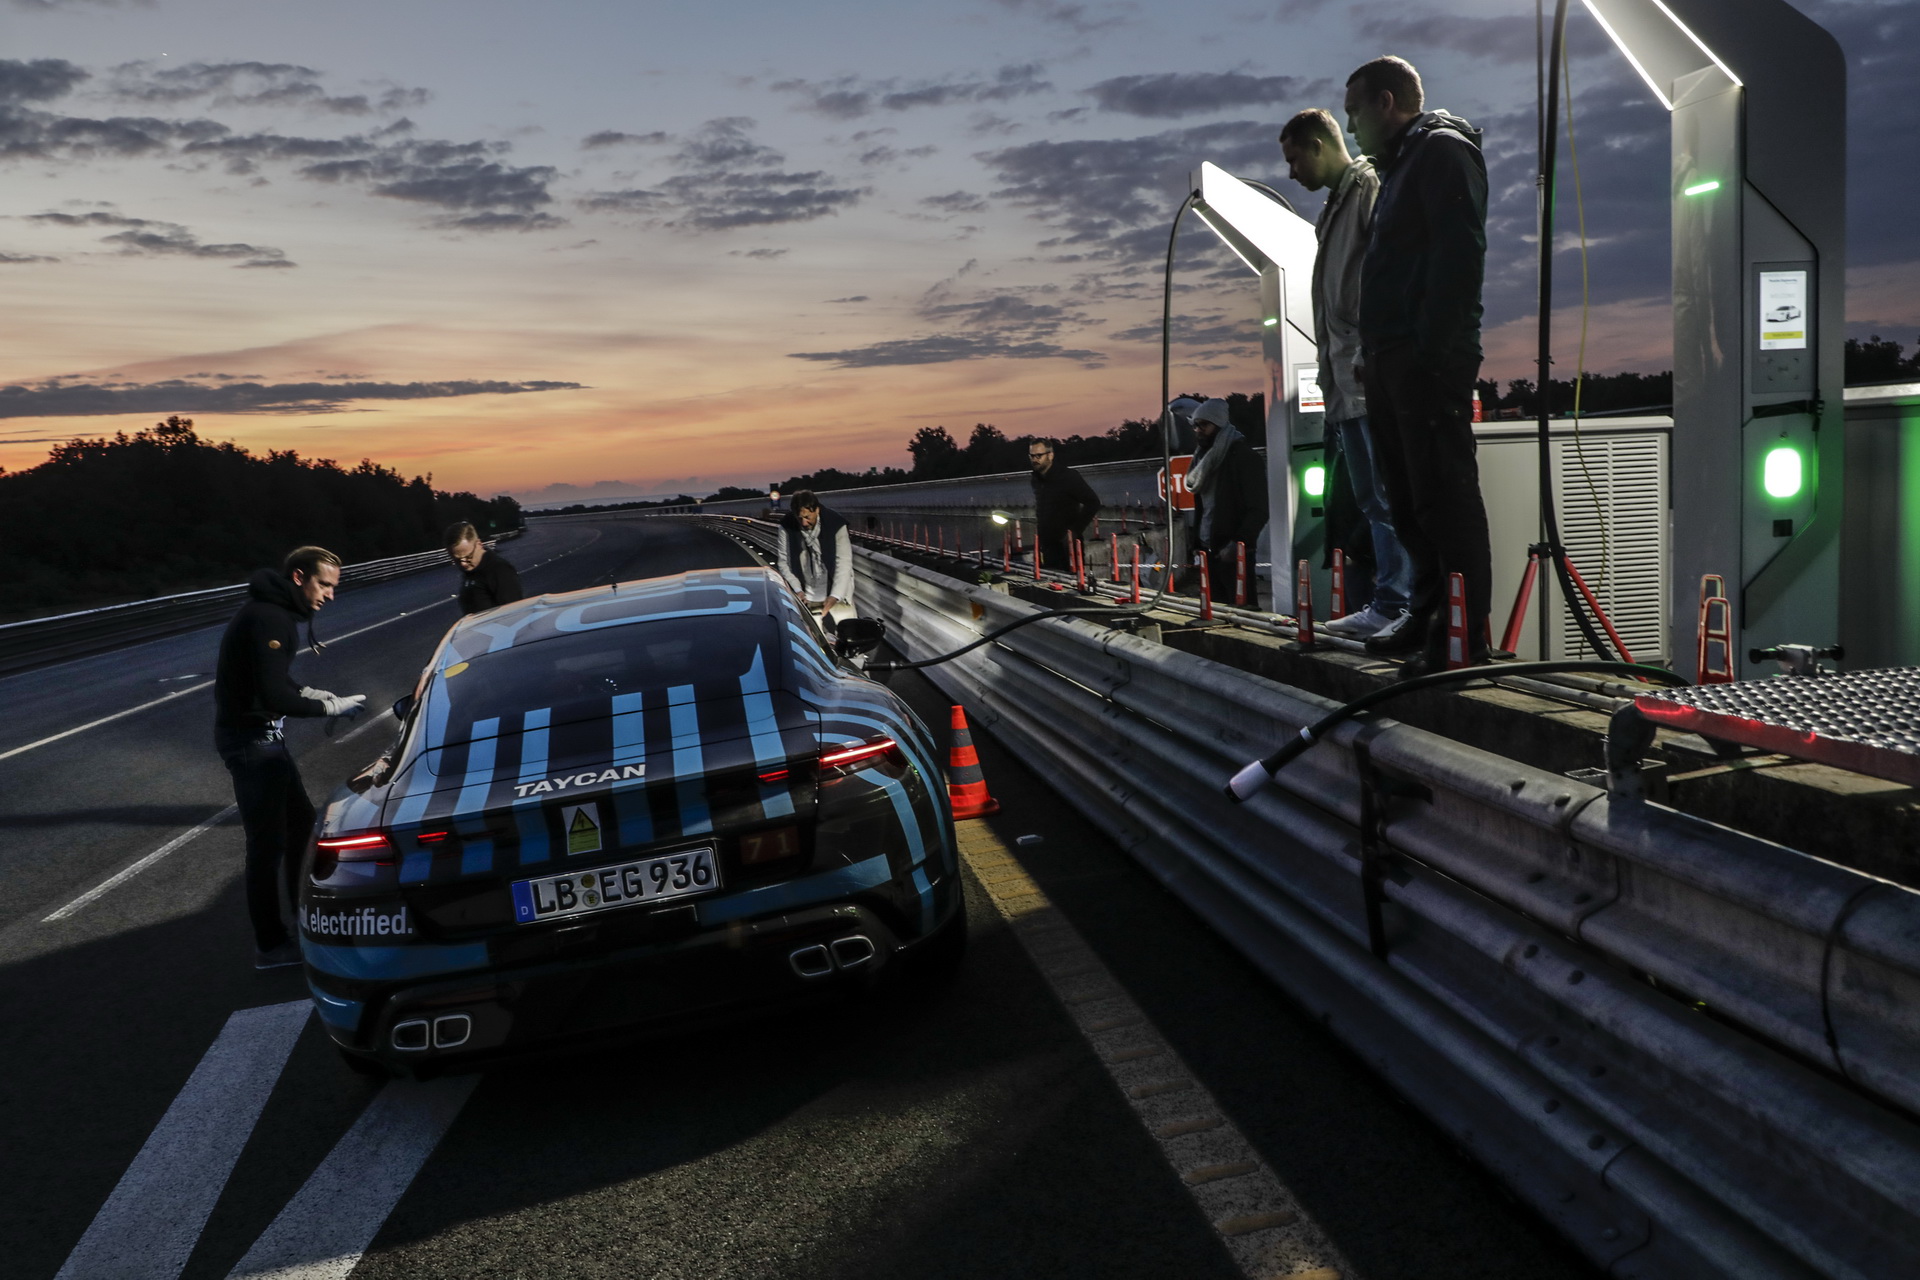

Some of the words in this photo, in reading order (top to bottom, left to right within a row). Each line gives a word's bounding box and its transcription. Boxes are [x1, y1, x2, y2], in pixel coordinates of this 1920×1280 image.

[514, 764, 646, 797] TAYCAN
[533, 879, 578, 915] LB
[599, 867, 644, 903] EG
[649, 855, 712, 895] 936
[310, 906, 413, 936] electrified.
[521, 905, 529, 916] D
